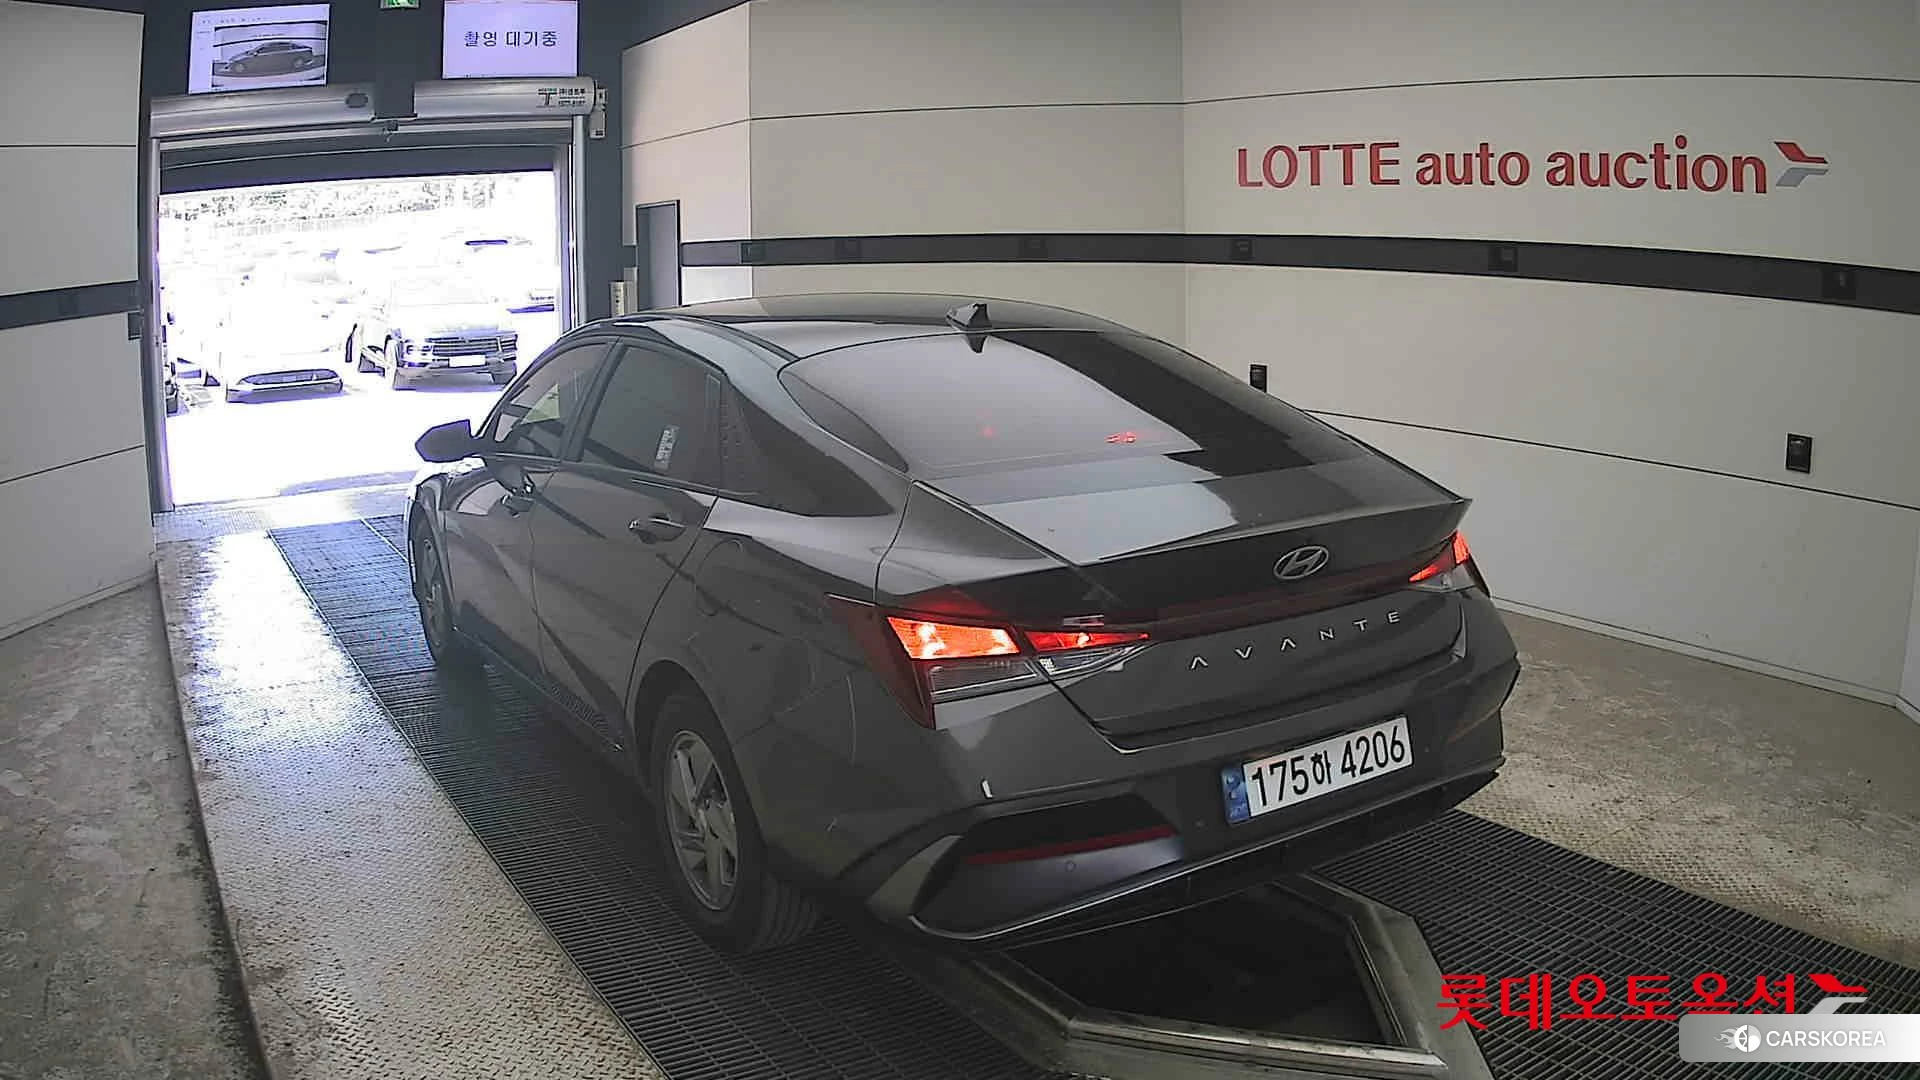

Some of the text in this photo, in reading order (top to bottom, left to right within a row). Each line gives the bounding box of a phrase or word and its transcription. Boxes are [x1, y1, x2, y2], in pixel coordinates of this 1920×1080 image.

[464, 31, 558, 47] 촬영 대기중
[1237, 135, 1767, 194] LOTTE auto auction
[1190, 610, 1401, 670] AVANTE
[1251, 750, 1332, 806] 175하
[1340, 725, 1406, 779] 4206
